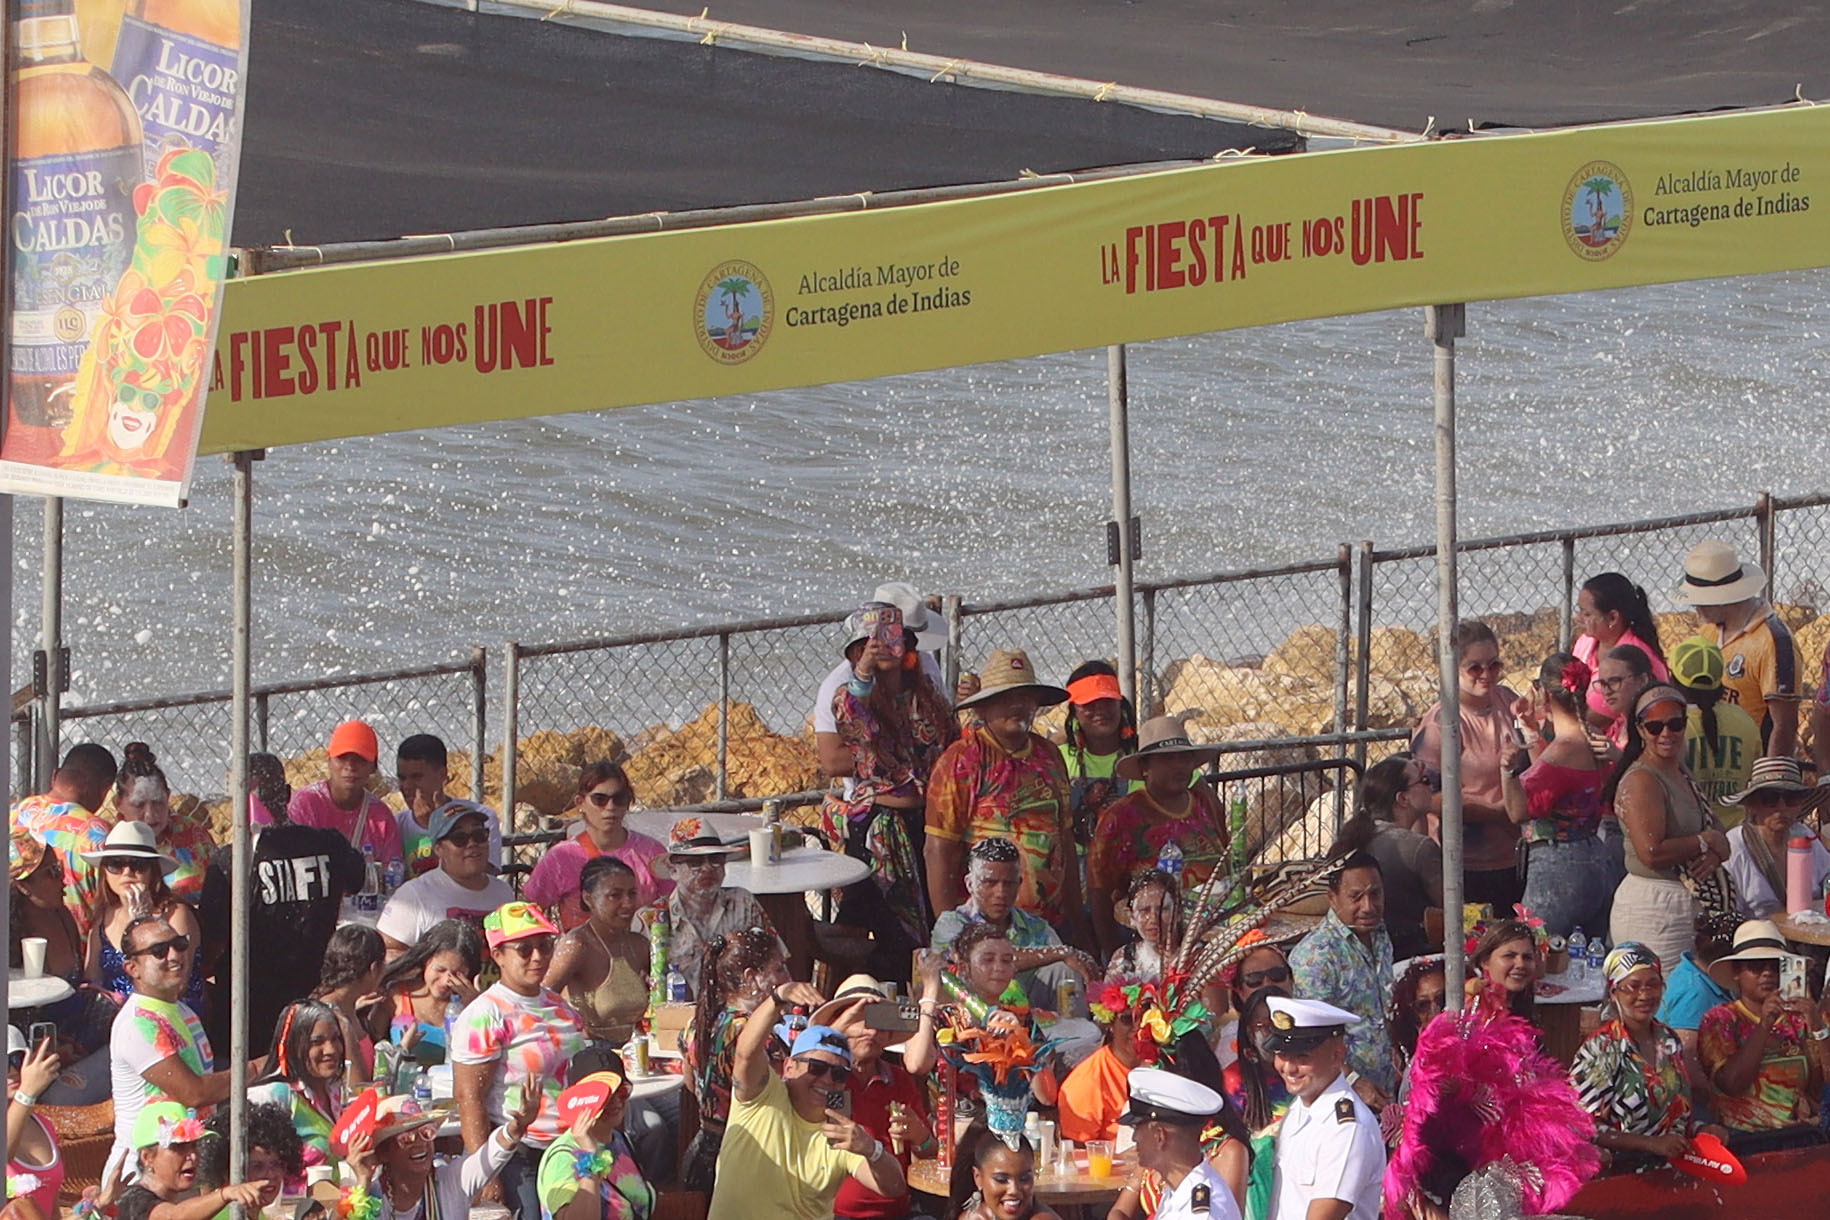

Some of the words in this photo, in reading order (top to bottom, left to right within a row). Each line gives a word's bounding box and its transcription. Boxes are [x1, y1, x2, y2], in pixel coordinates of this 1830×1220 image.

[156, 38, 239, 95] LICOR
[24, 168, 105, 203] LICOR
[1655, 169, 1722, 196] Alcaldía
[1725, 167, 1779, 192] Mayor
[1780, 162, 1801, 183] de
[1643, 203, 1733, 228] Cartagena
[1733, 196, 1753, 218] de
[1756, 191, 1810, 216] Indias
[11, 211, 125, 253] CALDAS
[1101, 243, 1120, 285] LA
[1125, 213, 1247, 295] FIESTA
[1251, 221, 1292, 264] QUE
[1302, 215, 1345, 259] NOS
[1351, 192, 1425, 266] UNE
[798, 266, 873, 295] Alcaldía
[876, 262, 936, 288] Mayor
[938, 255, 960, 278] de
[785, 301, 883, 328] Cartagena
[886, 293, 908, 315] de
[911, 287, 971, 313] Indias
[230, 320, 361, 402] FIESTA
[366, 328, 410, 373] QUE
[421, 322, 468, 367] NOS
[474, 296, 555, 374] UNE
[258, 854, 331, 905] STAFF
